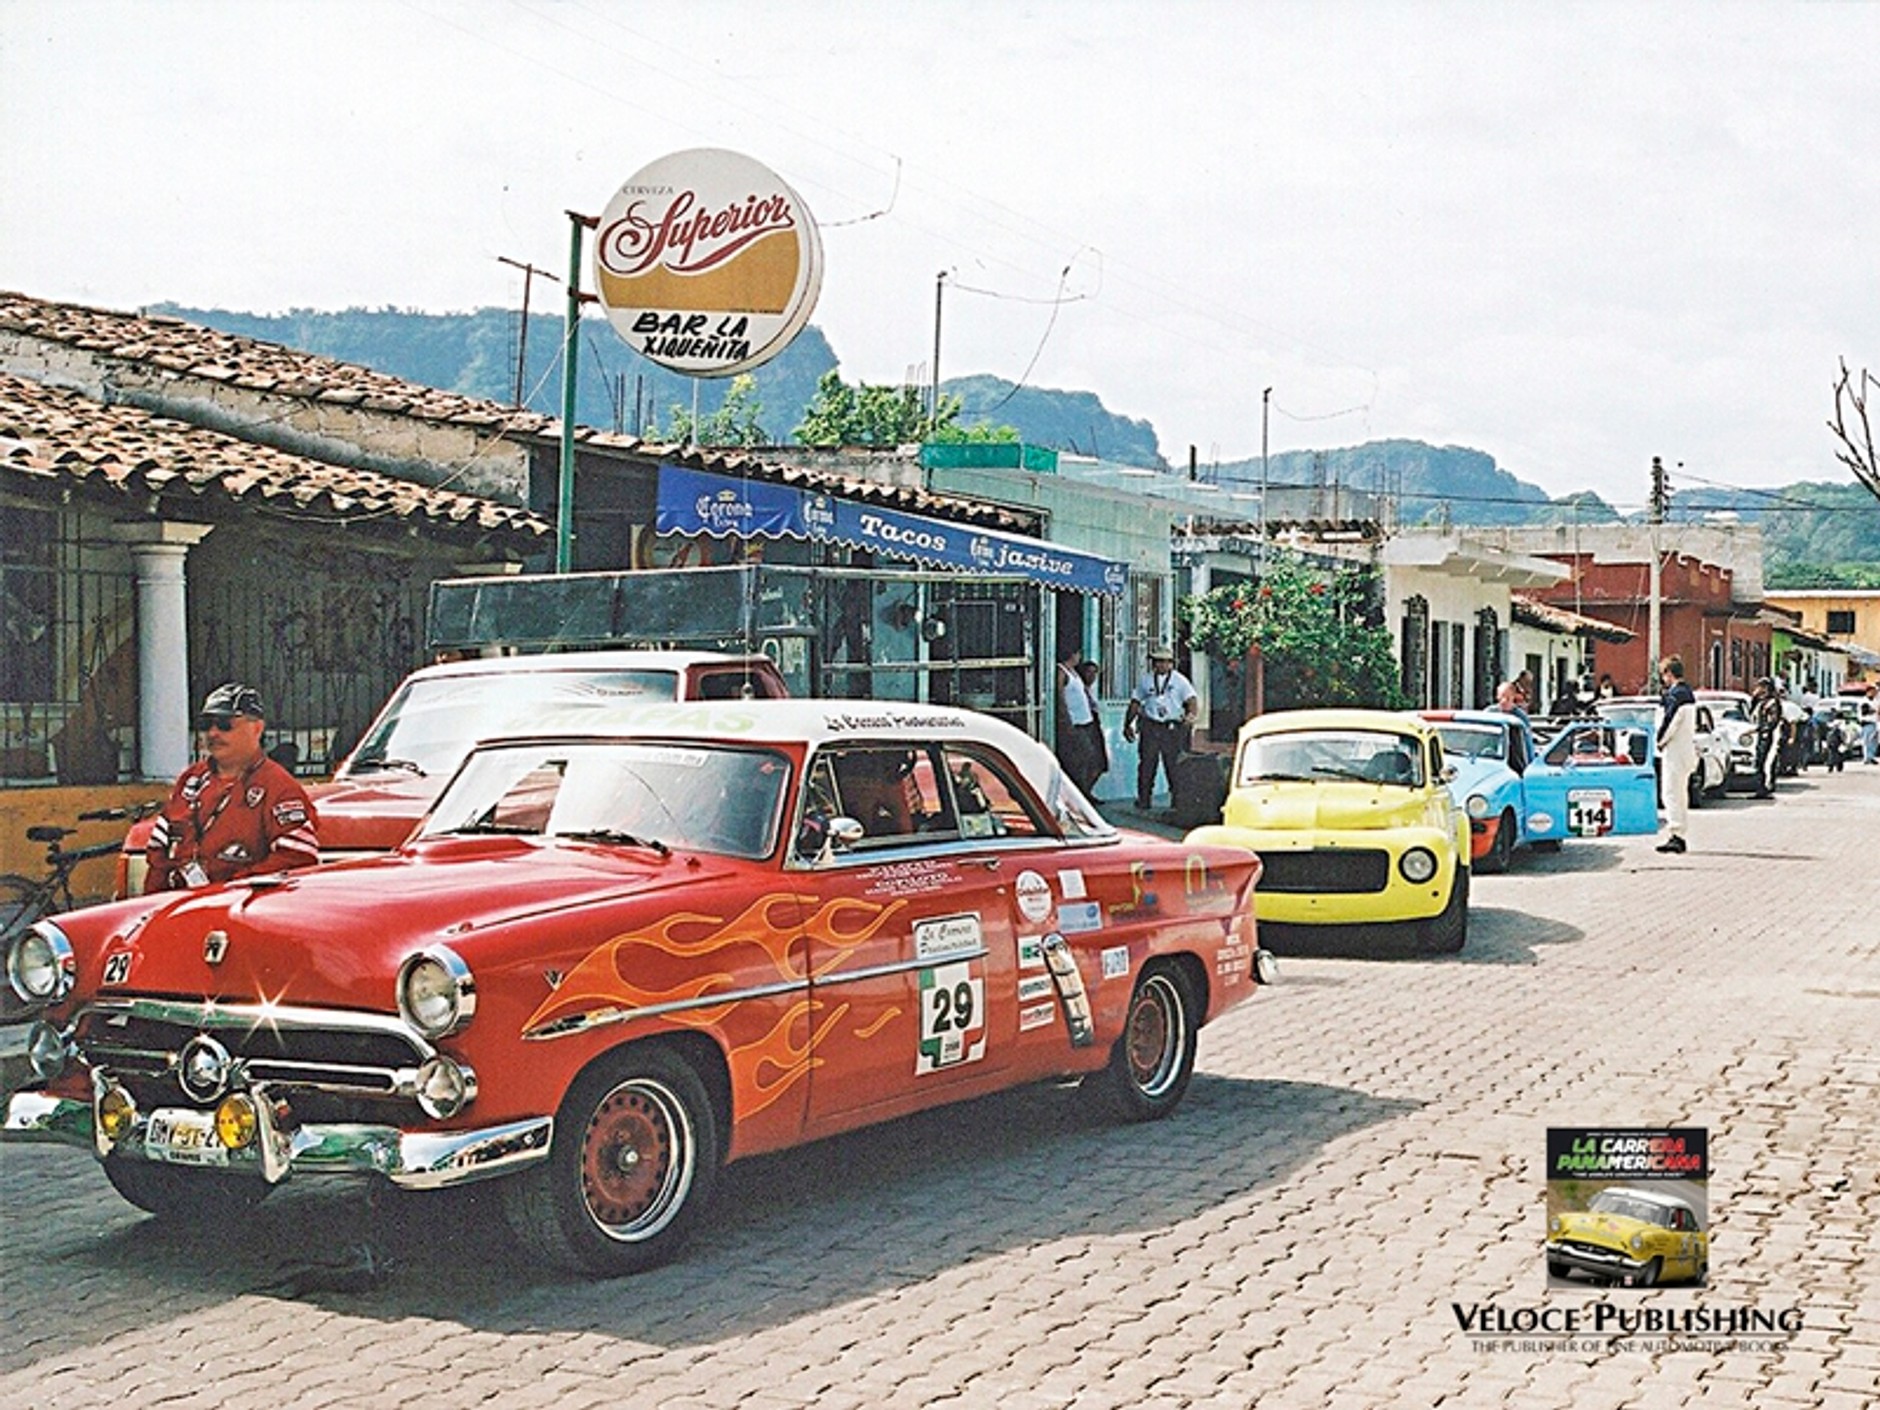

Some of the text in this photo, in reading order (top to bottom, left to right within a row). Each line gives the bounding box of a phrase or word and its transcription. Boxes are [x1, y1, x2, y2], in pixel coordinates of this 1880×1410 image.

[600, 190, 795, 274] Superior
[632, 312, 748, 337] BAR LA
[643, 334, 750, 360] XIQUEÑITA
[696, 496, 753, 519] Corona
[860, 514, 947, 551] Tacos
[1574, 808, 1608, 825] 114
[105, 954, 128, 982] 29
[933, 981, 973, 1034] 29
